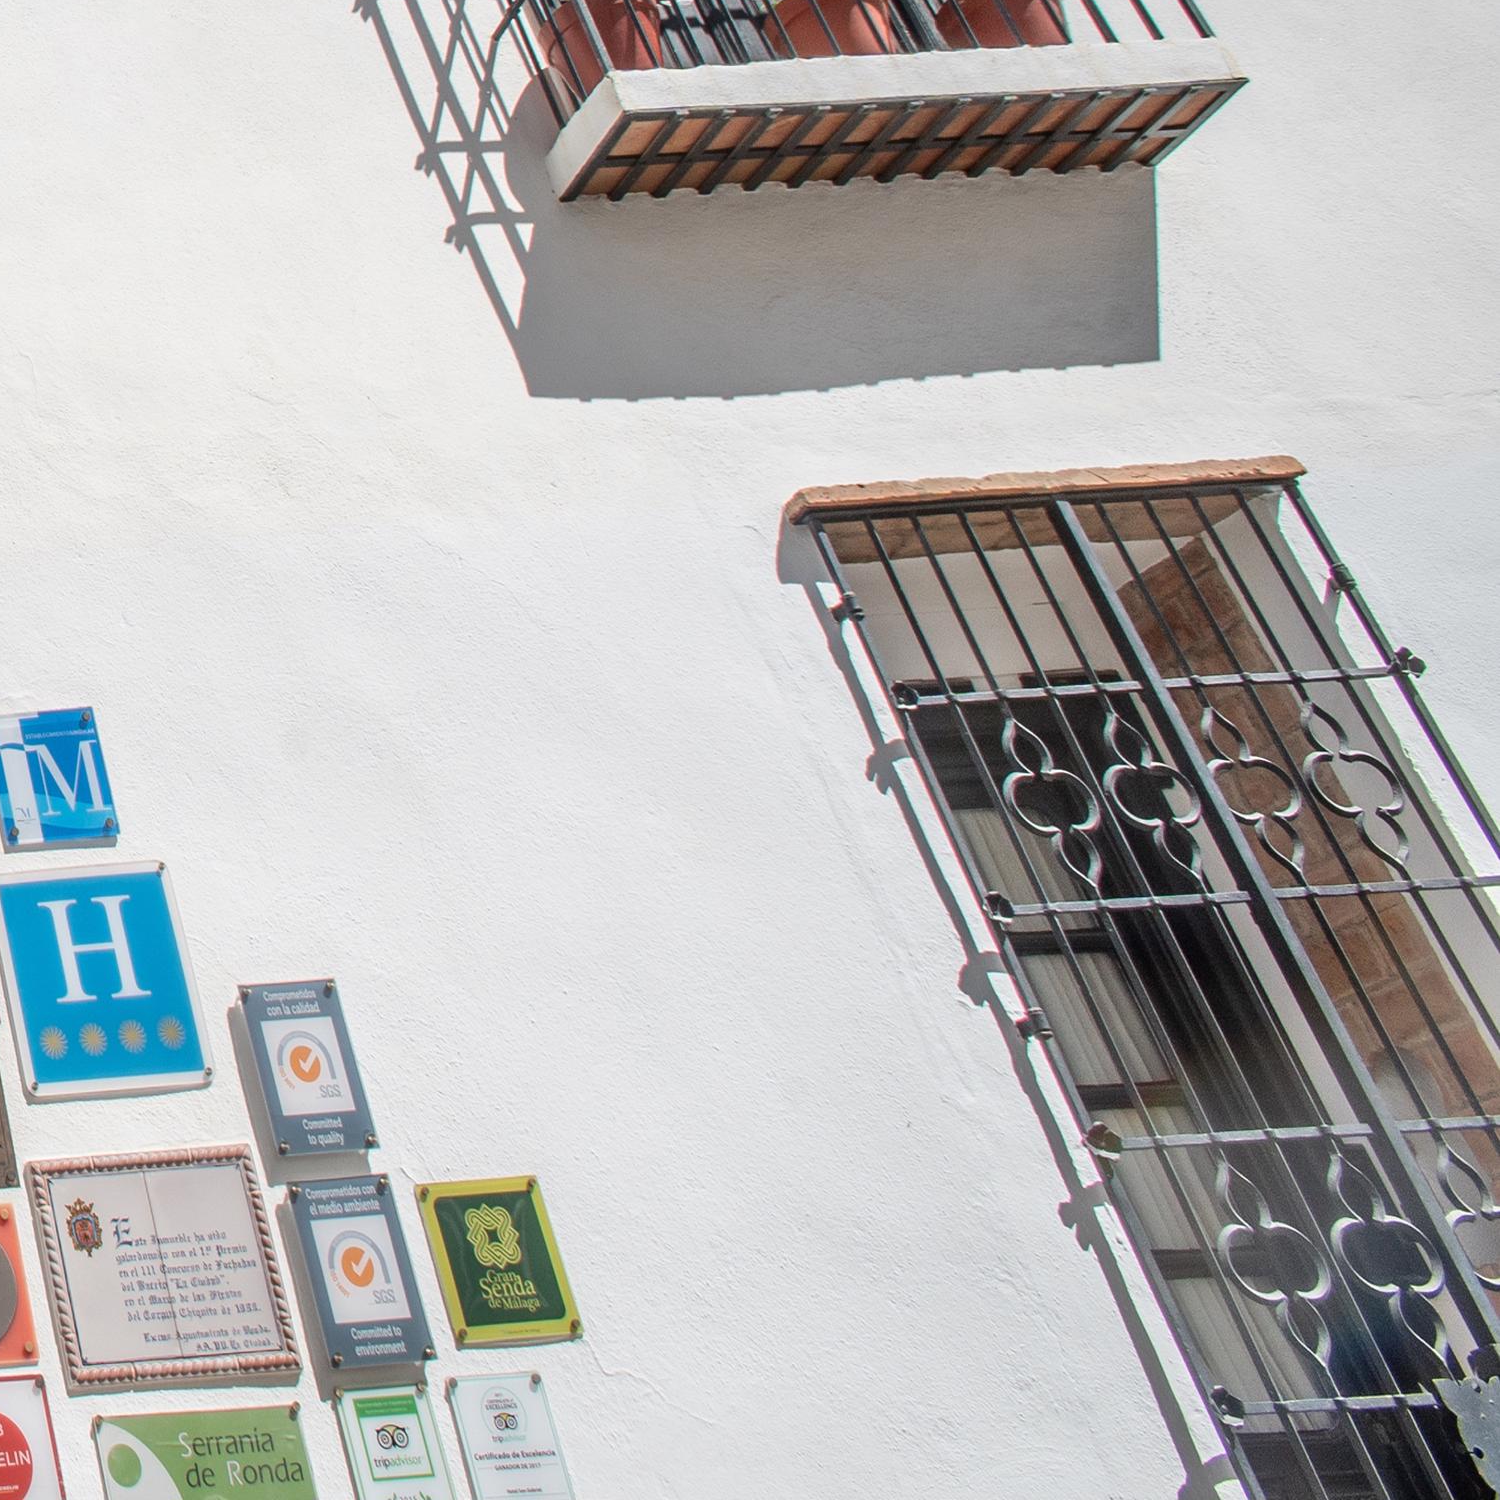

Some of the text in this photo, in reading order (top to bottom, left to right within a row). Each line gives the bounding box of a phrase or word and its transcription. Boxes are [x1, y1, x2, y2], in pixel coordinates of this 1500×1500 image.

[22, 740, 113, 816] M
[37, 894, 151, 1005] H
[262, 988, 317, 1002] Comprometidos
[266, 1001, 321, 1016] con la calidad
[319, 1084, 341, 1098] SGS
[302, 1116, 344, 1131] Committed
[308, 1131, 344, 1147] to quality
[305, 1185, 376, 1200] Comprometidos con
[309, 1199, 380, 1216] el medio ambiente
[110, 1217, 146, 1250] Este
[193, 1232, 205, 1244] ha
[189, 1247, 197, 1258] el
[216, 1245, 247, 1257] Premio
[119, 1270, 129, 1278] en
[130, 1266, 138, 1277] el
[202, 1261, 212, 1271] de
[486, 1270, 518, 1284] Gran
[121, 1281, 135, 1292] del
[479, 1275, 537, 1299] Senda
[124, 1299, 134, 1307] en
[137, 1296, 145, 1306] el
[179, 1292, 189, 1303] de
[192, 1292, 206, 1302] las
[372, 1289, 396, 1304] SGS
[488, 1295, 541, 1313] de Málaga
[127, 1310, 141, 1322] del
[221, 1305, 231, 1315] de
[232, 1326, 240, 1335] de
[350, 1325, 403, 1341] Committed to
[355, 1342, 407, 1357] environment
[373, 1455, 423, 1469] tripadvisor
[474, 1451, 511, 1461] Certificado
[520, 1449, 556, 1458] Excelencia
[186, 1457, 304, 1488] de Ronda
